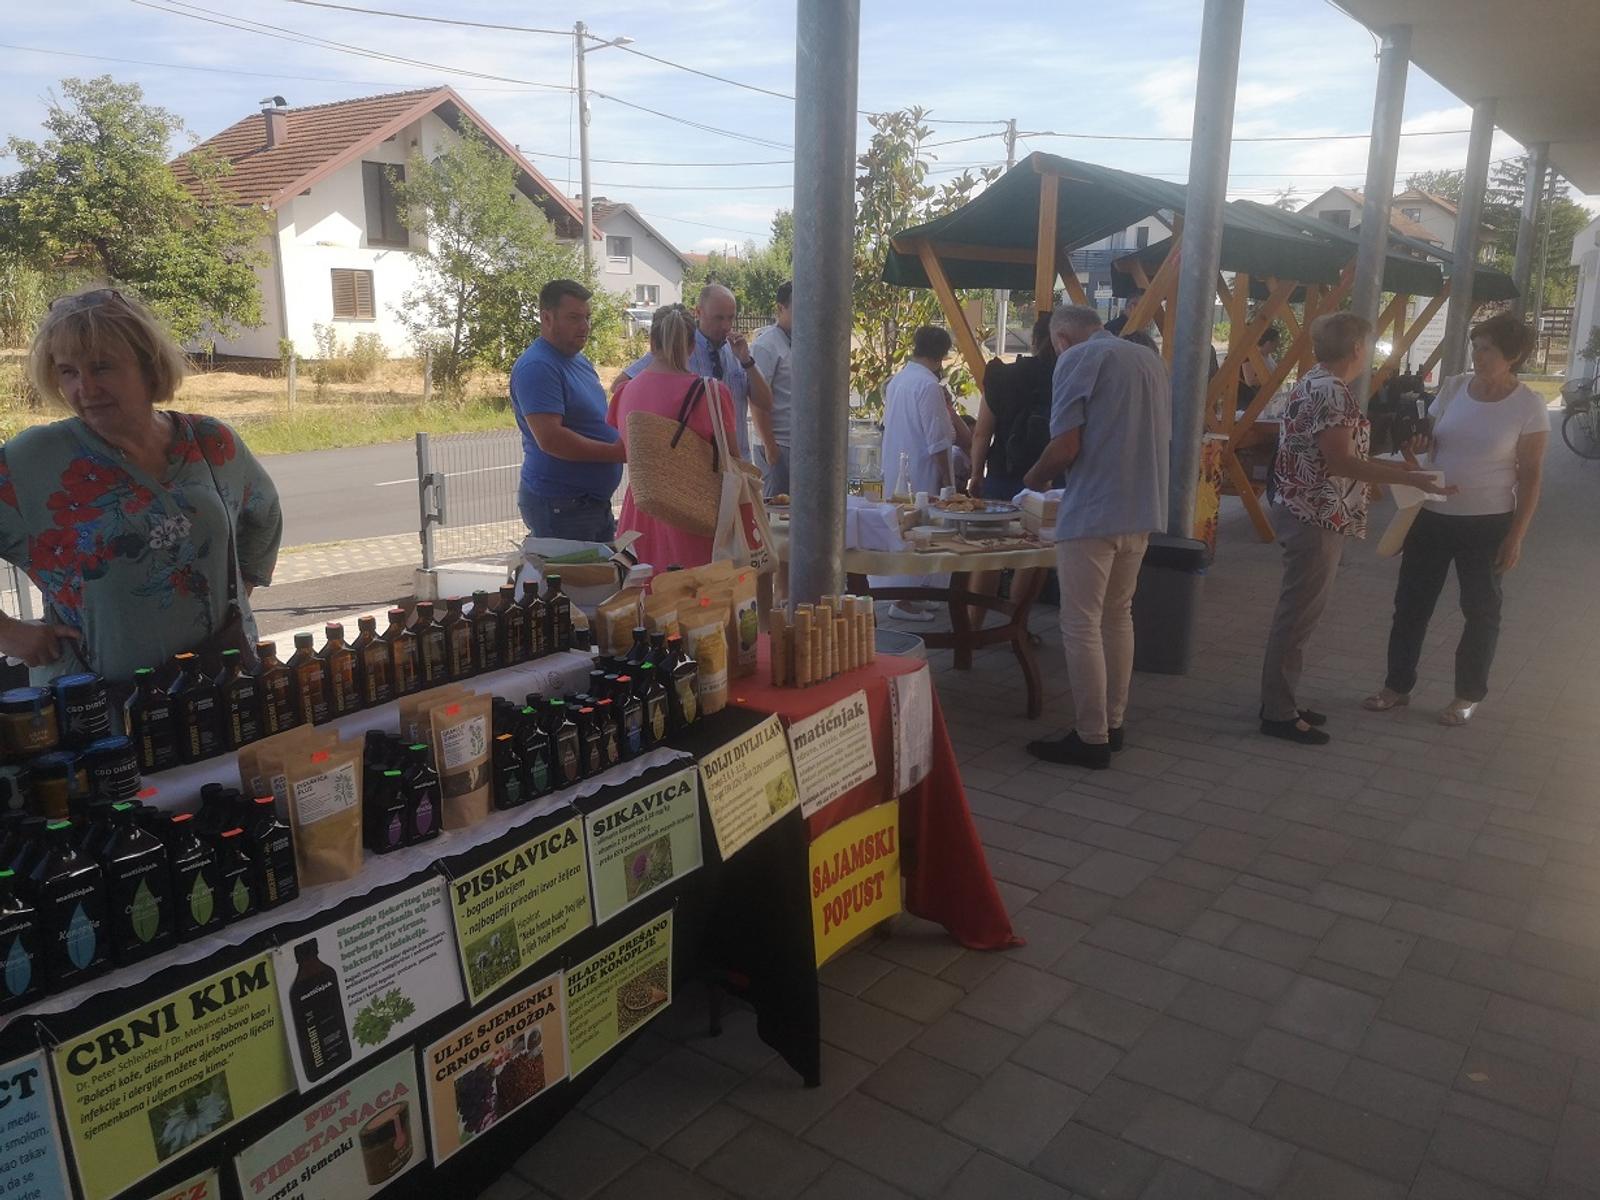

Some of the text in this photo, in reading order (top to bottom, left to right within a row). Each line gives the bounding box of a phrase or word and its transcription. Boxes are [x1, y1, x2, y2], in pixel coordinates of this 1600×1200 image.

[703, 751, 733, 779] BOLJI
[733, 732, 765, 760] DIVLJI
[592, 780, 692, 837] SIKAVICA
[456, 827, 578, 906] PISKAVICA
[812, 826, 896, 898] SAJAMSKI
[822, 870, 885, 936] POPUST
[568, 919, 668, 987] HLADNO PREŠANO
[568, 935, 657, 998] ULJE KONOPLJE
[66, 1002, 180, 1076] CRNI
[188, 961, 270, 1020] KIM
[433, 1031, 475, 1065] ULJE
[477, 985, 554, 1039] SJEMENKI
[76, 1078, 90, 1092] Dr.
[92, 1066, 116, 1085] Peter
[118, 1044, 163, 1071] Schleicher
[171, 1034, 185, 1046] Dr.
[144, 1054, 172, 1075] dišnih
[174, 1039, 205, 1062] puteva
[435, 1040, 492, 1082] CRNOG
[80, 1094, 121, 1124] infekcije
[165, 1056, 198, 1082] možete
[303, 1088, 352, 1132] PET
[83, 1102, 144, 1141] sjemenkama
[19, 1146, 48, 1165] takav
[22, 1171, 34, 1184] se
[300, 1137, 354, 1182] sjemenki
